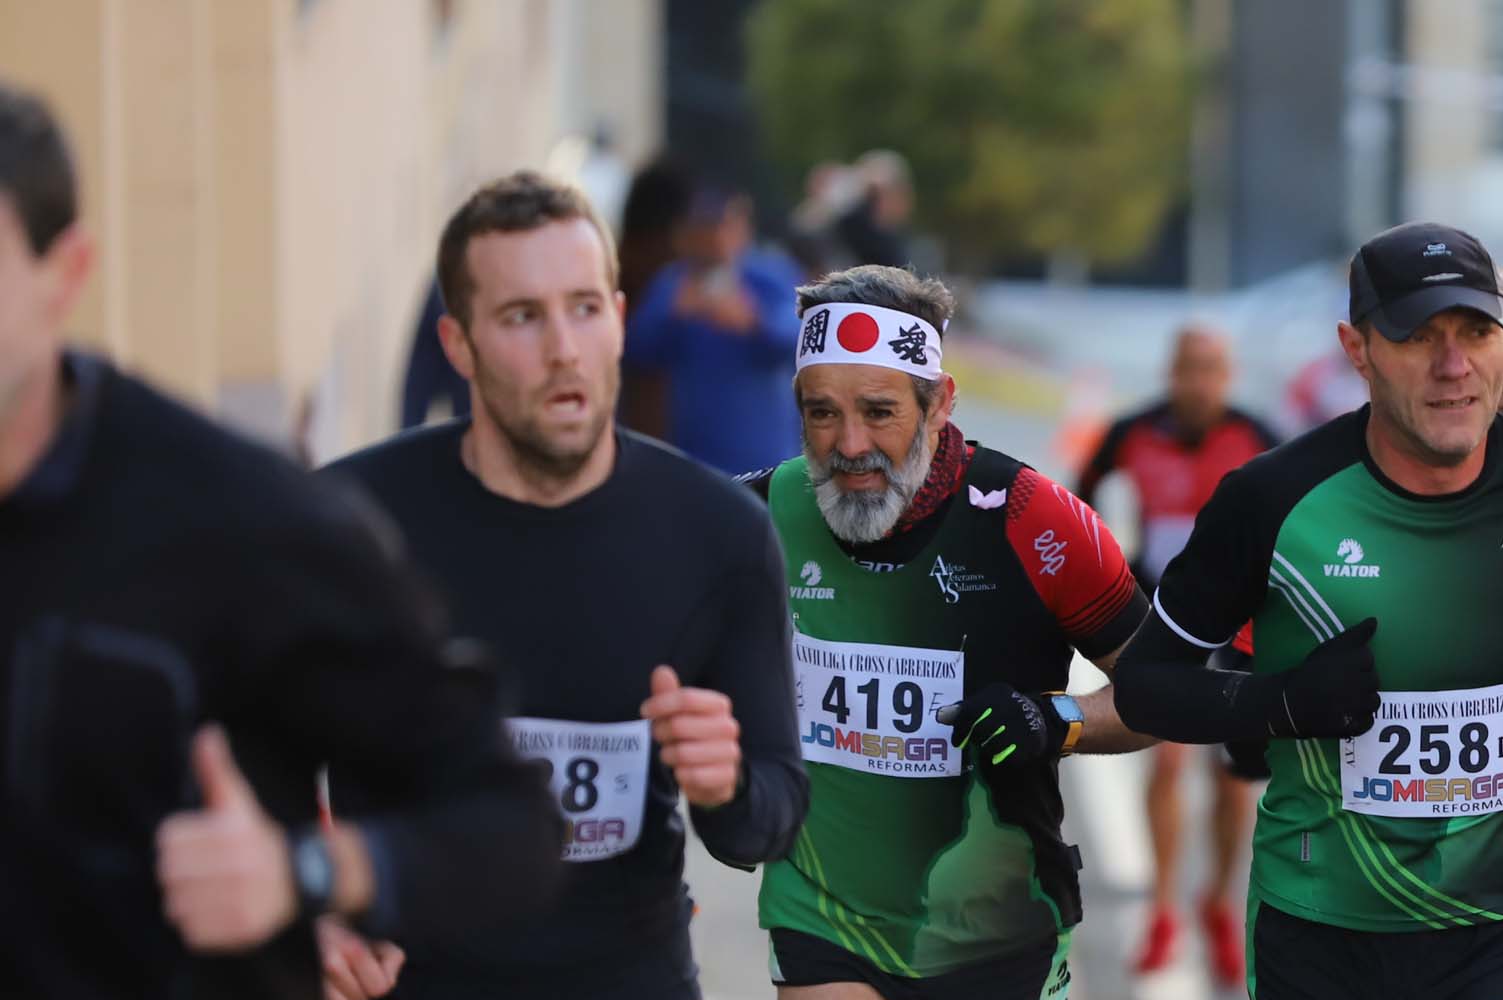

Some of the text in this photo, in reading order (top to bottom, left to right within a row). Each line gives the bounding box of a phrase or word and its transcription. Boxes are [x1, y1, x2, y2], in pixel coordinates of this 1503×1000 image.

[1323, 564, 1380, 577] VIATOR
[789, 586, 835, 600] VIATOR
[823, 651, 846, 671] LIGA
[849, 653, 885, 673] CROSS
[888, 656, 957, 679] CABRERIZOS
[822, 675, 924, 734] 419
[1382, 702, 1409, 720] LIGA
[1411, 701, 1449, 720] CROSS
[802, 721, 948, 761] JOMISAGA
[1378, 722, 1490, 775] 258
[869, 759, 946, 773] REFORMAS
